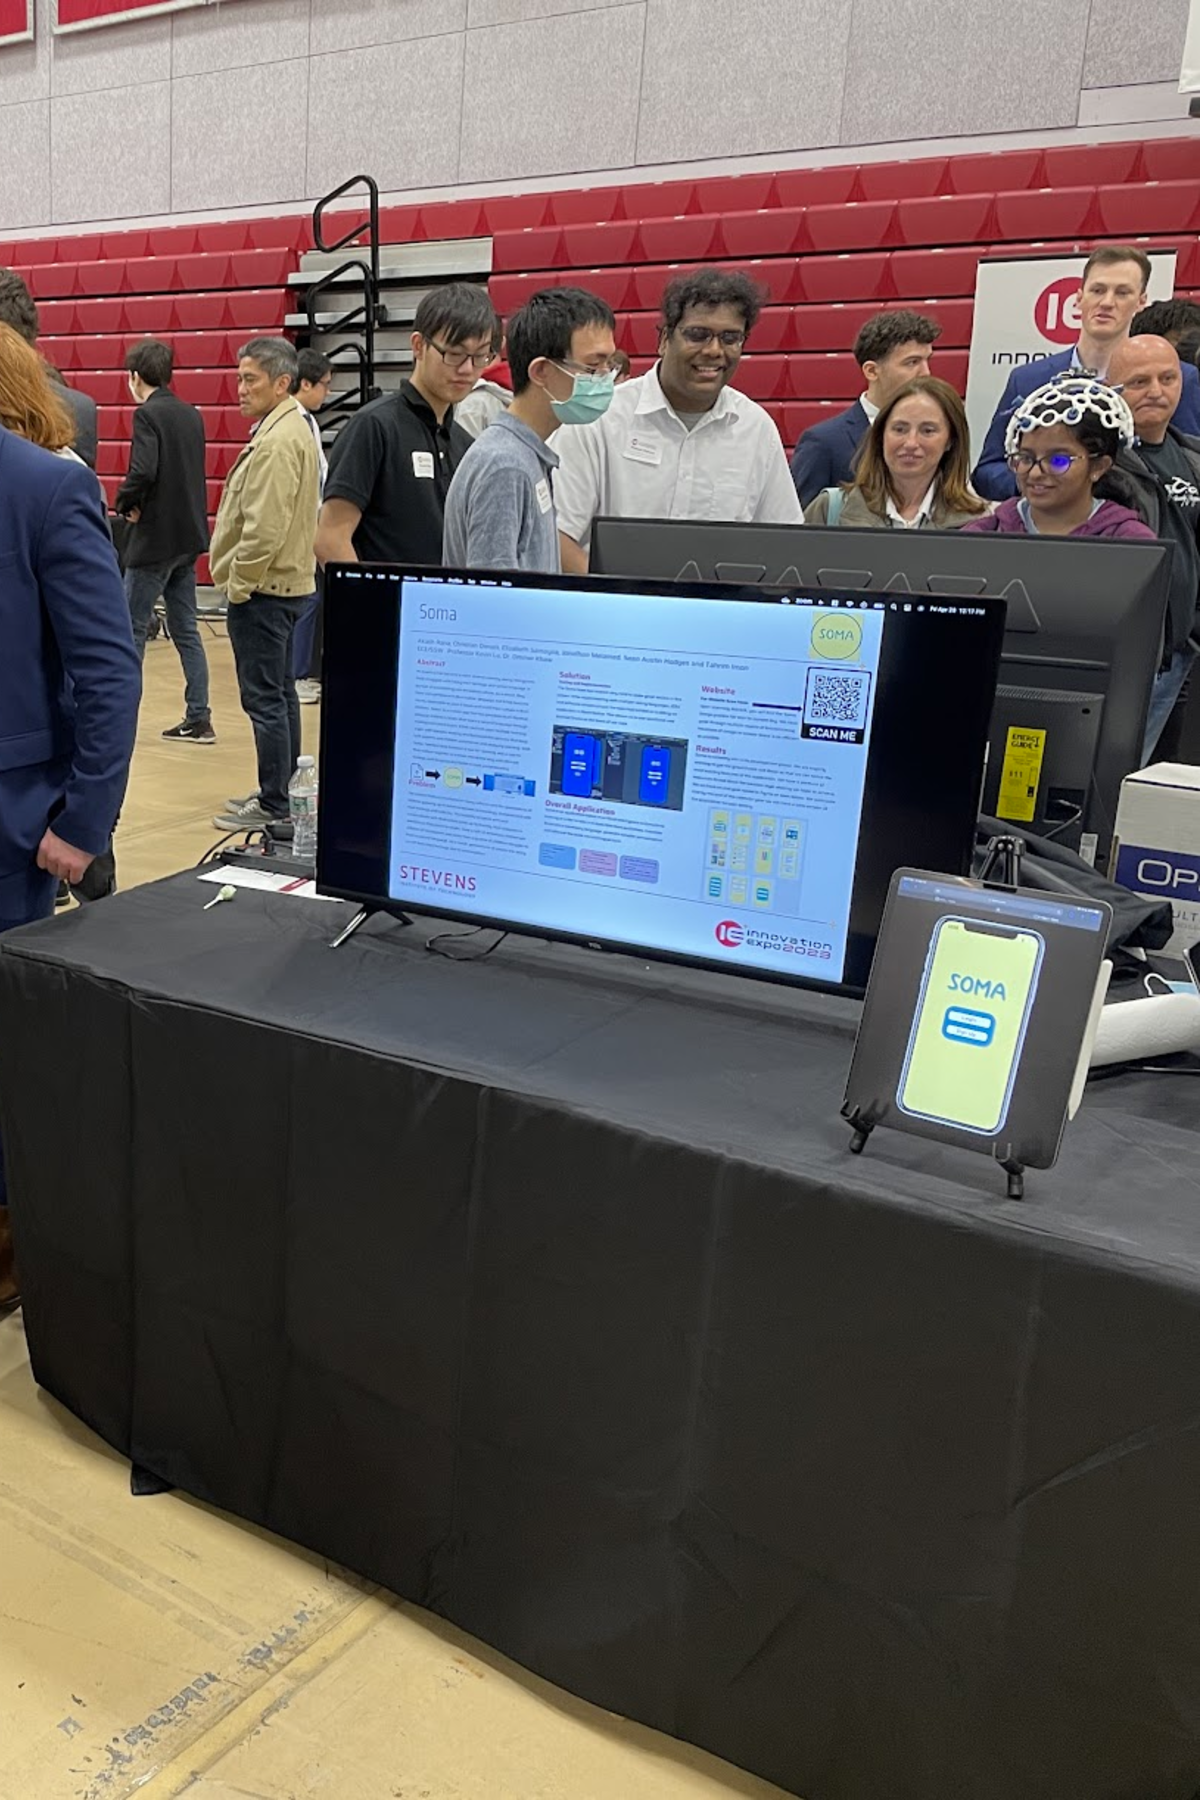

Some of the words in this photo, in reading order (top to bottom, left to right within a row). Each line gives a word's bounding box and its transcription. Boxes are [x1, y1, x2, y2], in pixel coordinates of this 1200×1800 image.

[419, 603, 457, 621] Soma
[819, 628, 855, 641] SOMA
[559, 671, 590, 680] Solution
[701, 685, 736, 696] Website
[809, 727, 839, 740] SCAN
[840, 730, 857, 741] ME
[696, 745, 726, 755] Results
[545, 800, 571, 810] Overall
[572, 804, 615, 816] Application
[400, 865, 477, 891] STEVENS
[746, 930, 833, 951] innovation
[746, 939, 831, 960] expo2023
[947, 973, 1006, 1001] SOMA
